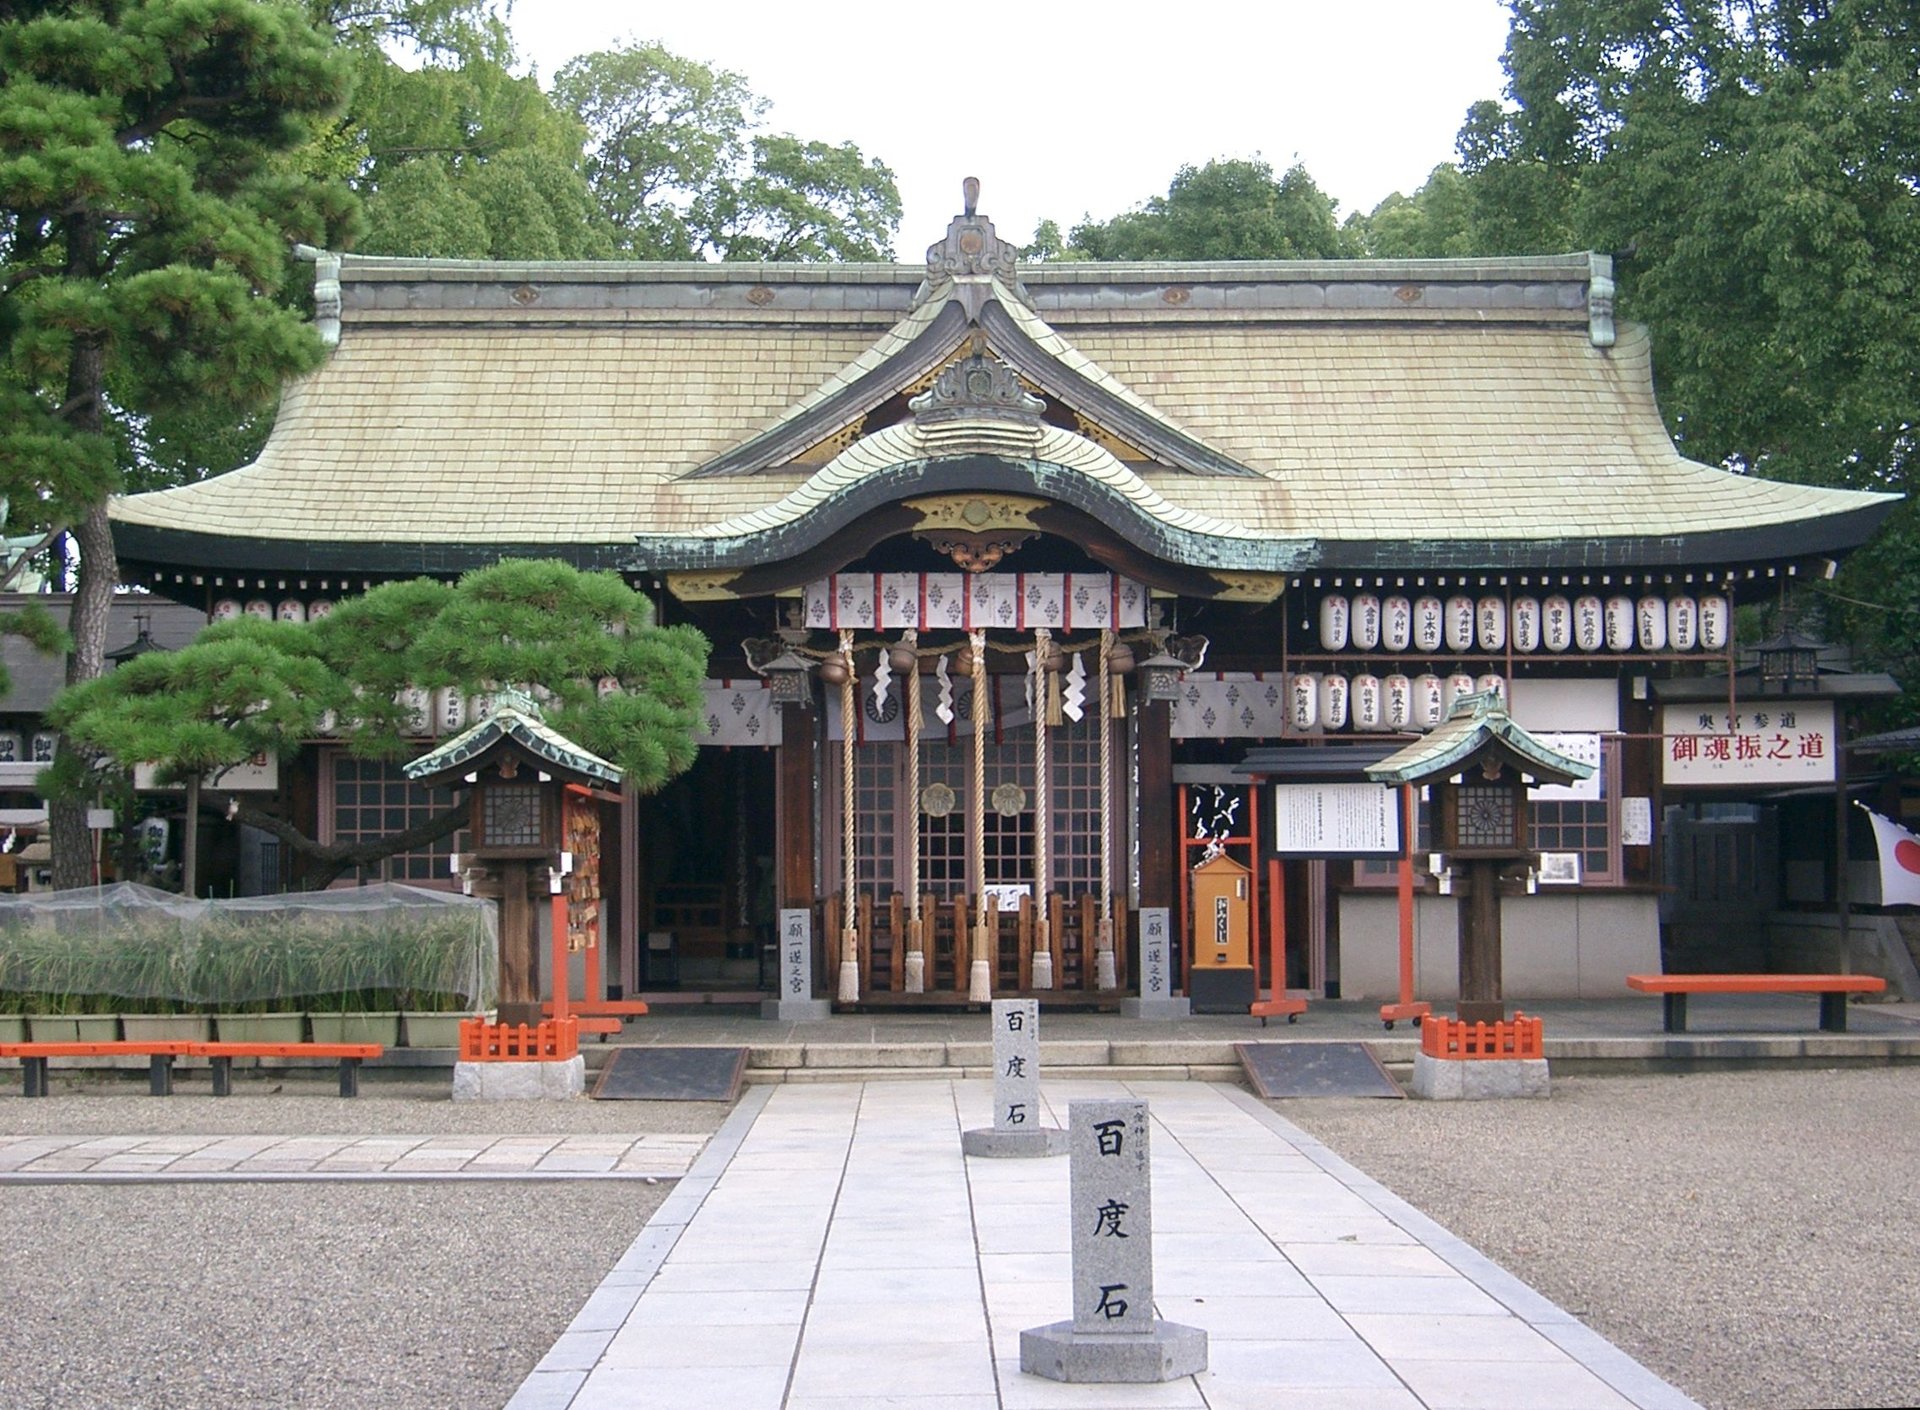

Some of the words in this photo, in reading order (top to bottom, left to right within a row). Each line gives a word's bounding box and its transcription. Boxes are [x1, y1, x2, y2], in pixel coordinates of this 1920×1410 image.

[1672, 732, 1825, 761] 御魂振之道
[1005, 1010, 1027, 1124] 百度石
[1093, 1119, 1130, 1319] 百度石
